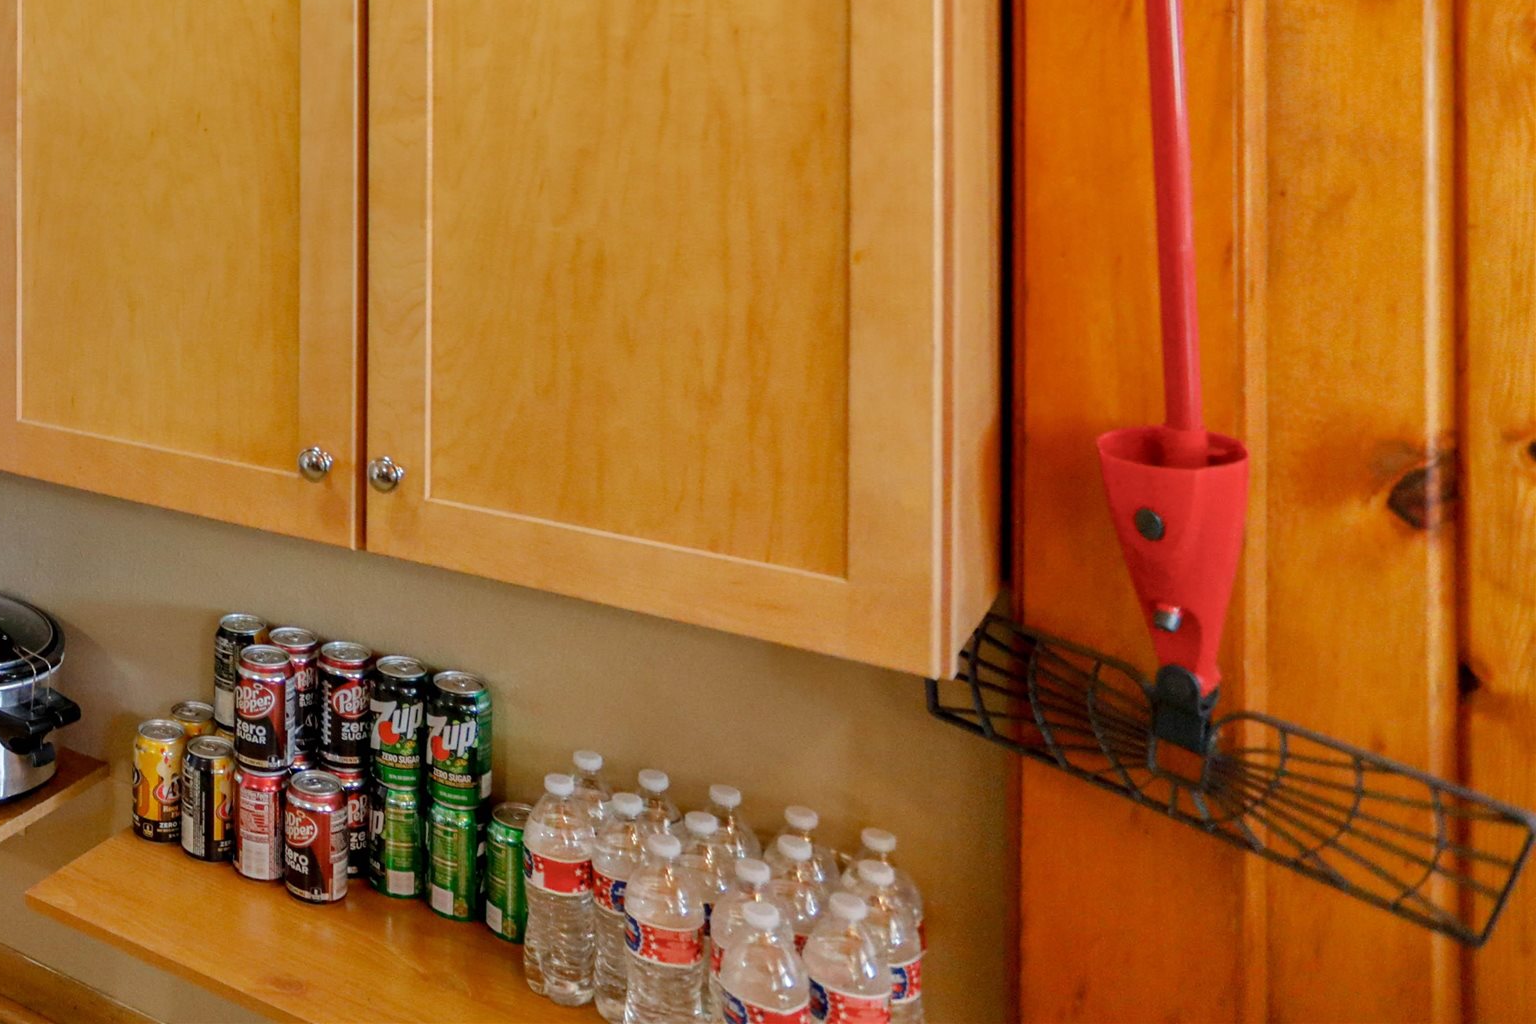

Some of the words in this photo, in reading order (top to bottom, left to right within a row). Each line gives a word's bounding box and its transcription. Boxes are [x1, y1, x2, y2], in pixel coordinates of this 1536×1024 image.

[235, 687, 272, 713] Pepper
[245, 684, 260, 699] Dr
[237, 718, 267, 736] zero
[370, 698, 423, 750] 7up
[237, 728, 267, 745] SUGAR
[341, 731, 368, 741] SUGA
[426, 712, 478, 765] 7up
[382, 752, 399, 763] ZERO
[399, 754, 420, 765] SUGAR
[433, 767, 449, 780] ZERO
[448, 774, 472, 784] SUGAR
